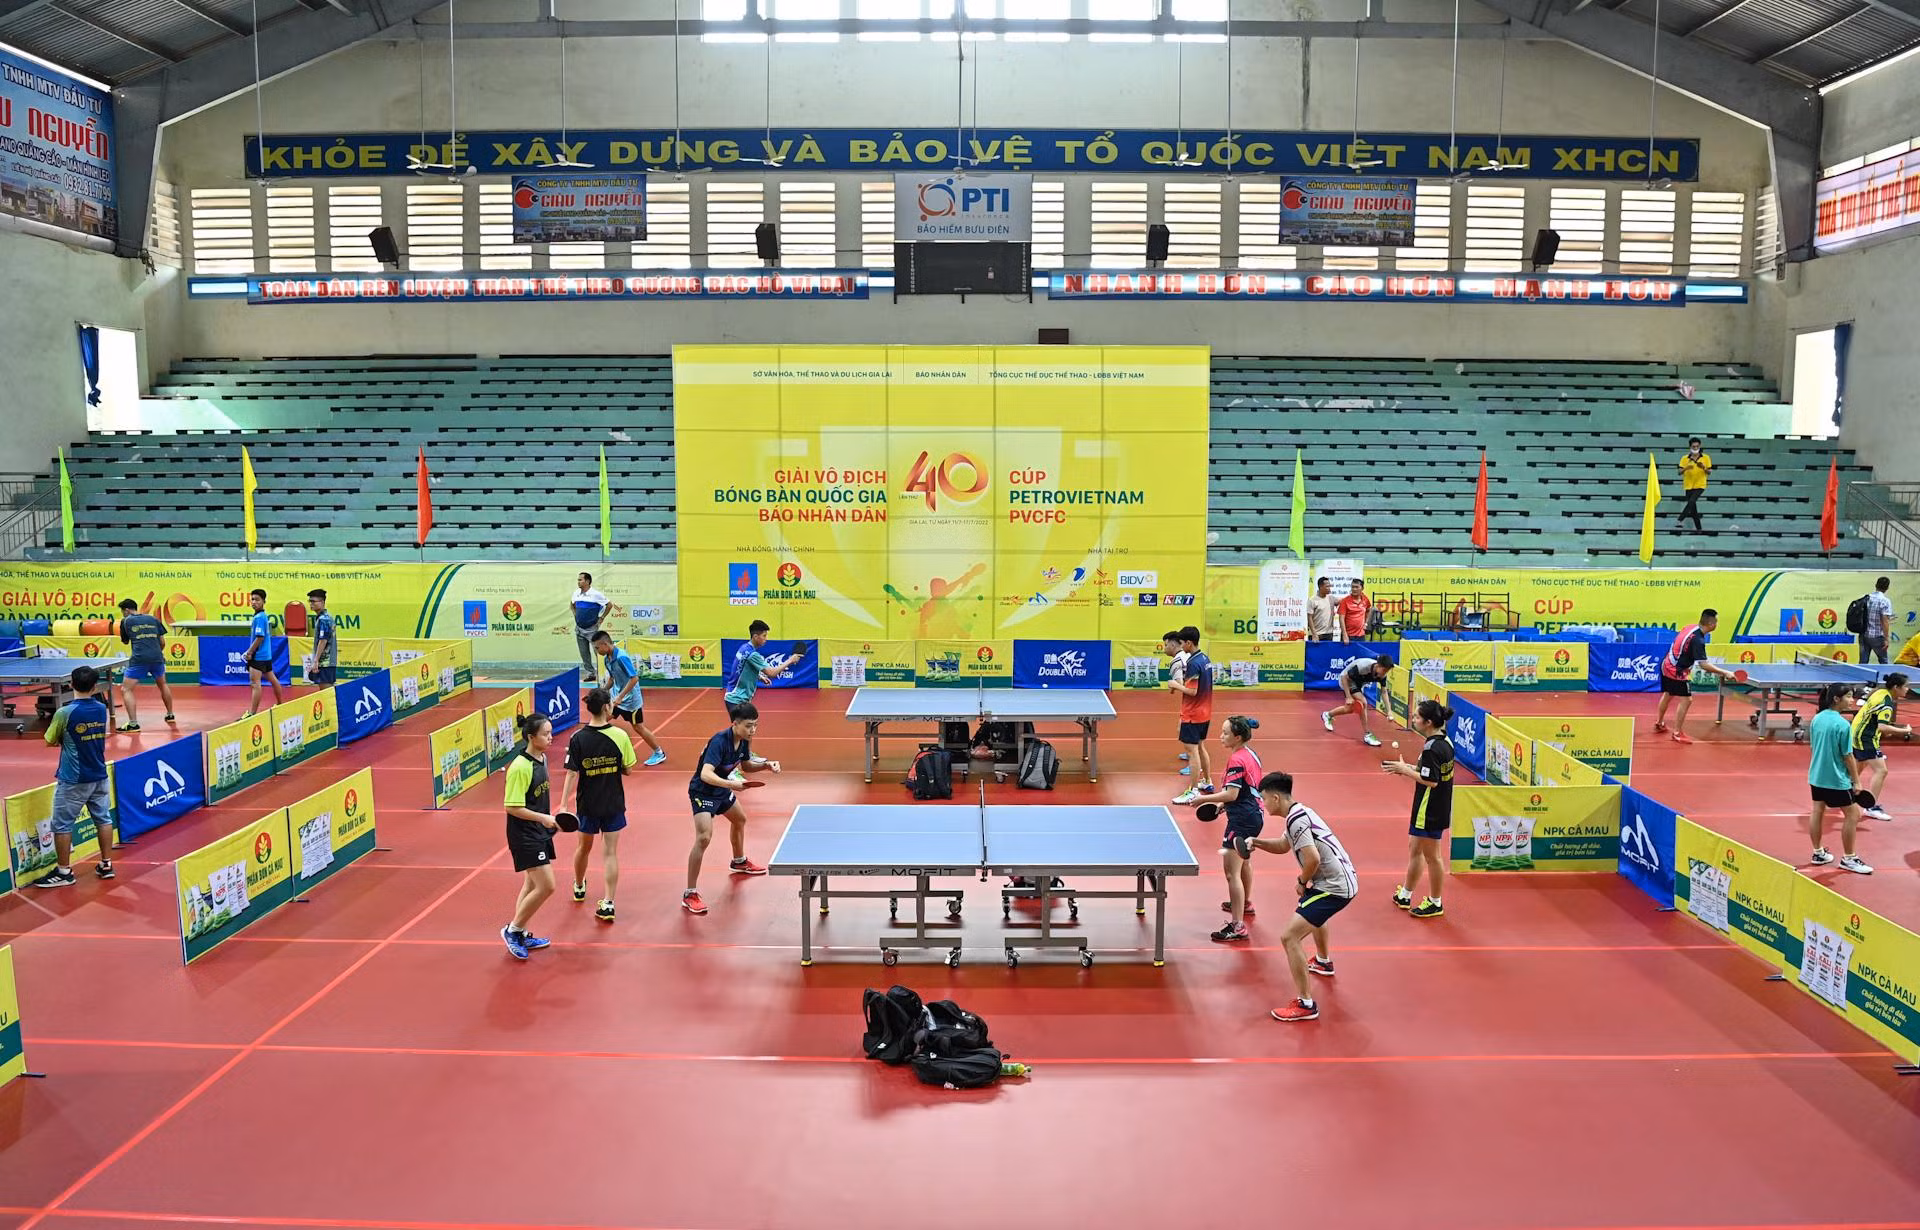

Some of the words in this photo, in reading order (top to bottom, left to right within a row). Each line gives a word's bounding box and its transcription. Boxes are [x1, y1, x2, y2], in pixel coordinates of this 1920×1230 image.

[2, 63, 34, 90] TNHH
[37, 77, 61, 100] MTV
[63, 85, 85, 109] ĐẦU
[88, 99, 103, 115] TƯ
[262, 138, 387, 169] KHỎE
[409, 133, 470, 166] ĐỂ
[492, 138, 588, 166] XÂY
[610, 136, 740, 170] DỰNG
[761, 134, 826, 165] VÀ
[850, 132, 948, 163] BẢO
[969, 135, 1033, 170] VỆ
[1056, 131, 1119, 164] TỔ
[1141, 134, 1275, 167] QUỐC
[1296, 140, 1408, 174] VIỆT
[1428, 146, 1531, 169] NAM
[1553, 147, 1680, 173] XHCN
[541, 192, 576, 208] GIÀU
[962, 188, 1010, 212] PTI
[917, 225, 936, 234] BẢO
[940, 223, 963, 234] HIỂM
[965, 226, 985, 234] BƯU
[988, 225, 1010, 234] ĐIỆN
[259, 279, 310, 298] TOÀN
[317, 277, 356, 298] DÂN
[359, 277, 399, 297] RÈN
[405, 277, 466, 299] LUYỆN
[472, 277, 525, 297] THÂN
[530, 273, 569, 294] THỂ
[574, 278, 625, 294] THEO
[631, 275, 701, 295] GƯƠNG
[708, 274, 749, 294] BÁC
[757, 272, 786, 294] HỒ
[819, 276, 855, 297] ĐẠI
[1064, 274, 1184, 295] NHANH
[1196, 273, 1267, 296] HƠN
[1304, 276, 1374, 297] CAO
[1386, 275, 1456, 298] HƠN
[1493, 278, 1590, 302] MẠNH
[1605, 277, 1673, 302] HƠN
[753, 369, 763, 377] SỞ
[779, 370, 795, 378] HÓA,
[796, 369, 810, 377] THỂ
[830, 369, 840, 377] VÀ
[852, 370, 868, 379] LỊCH
[931, 370, 949, 378] NHÂN
[951, 370, 966, 378] DÂN
[989, 370, 1007, 379] TỔNG
[1008, 371, 1024, 381] CỤC
[1024, 370, 1038, 379] THỂ
[1038, 371, 1054, 381] DỤC
[1054, 370, 1068, 379] THỂ
[1069, 371, 1088, 379] THAO
[1112, 371, 1127, 380] VIỆT
[774, 466, 810, 484] GIẢI
[814, 466, 839, 484] VÔ
[842, 469, 887, 486] ĐỊCH
[905, 451, 989, 513] 40
[1009, 466, 1046, 485] CÚP
[714, 485, 762, 503] BÓNG
[766, 486, 801, 503] BÀN
[804, 485, 854, 505] QUỐC
[857, 489, 887, 504] GIA
[1009, 490, 1144, 505] PETROVIETNAM
[759, 506, 794, 523] BÁO
[798, 505, 847, 523] NHÂN
[851, 505, 887, 523] DÂN
[1009, 510, 1066, 524] PVCFC
[736, 545, 752, 553] NHÀ
[752, 545, 772, 553] ĐỒNG
[773, 545, 792, 553] HÀNH
[793, 545, 815, 553] CHÍNH
[1114, 547, 1129, 555] TRỢ
[1120, 575, 1145, 585] BIDV
[1450, 577, 1465, 585] BÁO
[1465, 577, 1486, 586] NHÂN
[1487, 577, 1507, 586] DÂN
[1531, 577, 1551, 586] TỔNG
[1551, 578, 1572, 588] CỤC
[1572, 577, 1586, 586] THỂ
[1586, 578, 1603, 588] DỤC
[1603, 577, 1618, 587] THỂ
[1619, 579, 1640, 587] THAO
[1666, 578, 1683, 588] VIỆT
[1683, 579, 1701, 587] NAM
[3, 587, 37, 607] GIẢI
[42, 588, 67, 607] VÔ
[71, 592, 116, 610] ĐỊCH
[763, 589, 780, 599] PHÂN
[793, 589, 802, 599] CÀ
[803, 589, 816, 599] MAU
[1163, 595, 1195, 606] KRT
[732, 598, 756, 606] PVCFC
[1534, 595, 1574, 615] CÚP
[632, 609, 652, 618] BIDV
[885, 661, 894, 669] CÀ
[1038, 667, 1066, 677] DOUBLE
[1073, 668, 1087, 677] FISH
[779, 671, 794, 679] FISH
[1611, 670, 1638, 681] DOUBLE
[1645, 672, 1659, 681] FISH
[355, 706, 383, 724] MOFIT
[1570, 749, 1588, 757] NPK
[1590, 747, 1602, 757] CÀ
[1604, 749, 1623, 757] MAU
[145, 786, 186, 809] MOFIT
[1543, 826, 1565, 836] NPK
[1567, 825, 1582, 836] CÀ
[1585, 826, 1609, 836] MAU
[1620, 846, 1659, 874] MOFIT
[892, 868, 957, 876] MOFIT
[1735, 891, 1752, 906] NPK
[1752, 898, 1764, 912] CÀ
[1765, 906, 1785, 923] MAU
[1857, 963, 1877, 984] NPK
[1878, 973, 1892, 992] CÀ
[1893, 984, 1917, 1006] MAU
[1861, 988, 1874, 1002] Chất
